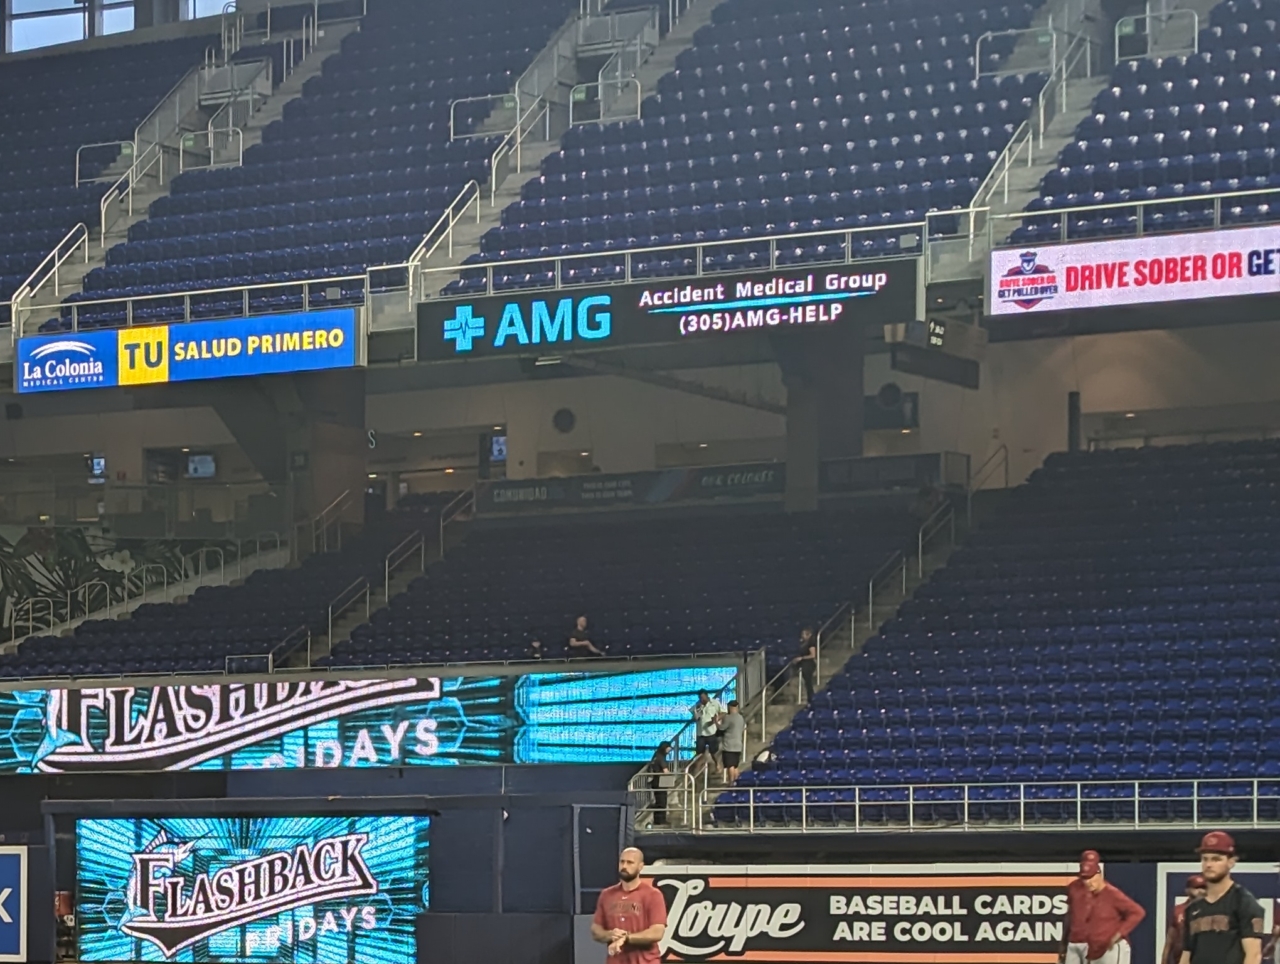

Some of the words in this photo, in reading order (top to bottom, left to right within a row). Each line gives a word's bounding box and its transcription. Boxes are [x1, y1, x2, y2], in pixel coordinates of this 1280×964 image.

[639, 283, 724, 308] Accident
[736, 275, 812, 300] Medical
[825, 271, 887, 294] Group
[1065, 261, 1130, 292] DRIVE
[1133, 254, 1207, 287] SOBER
[1211, 251, 1243, 280] OR
[493, 295, 611, 347] AMG
[680, 302, 843, 335] (305)AMG-HELP
[23, 362, 42, 380] La
[45, 357, 104, 378] Colonia
[123, 340, 164, 370] TU
[174, 337, 242, 362] SALUD
[247, 328, 344, 355] PRIMERO
[132, 832, 377, 922] FLASHBACK
[656, 878, 806, 956] Loupe
[829, 893, 967, 916] BASEBALL
[972, 893, 1069, 915] CARDS
[246, 906, 377, 956] FRIDAYS
[833, 921, 887, 942] ARE
[892, 920, 969, 943] COOL
[974, 920, 1064, 943] AGAIN
